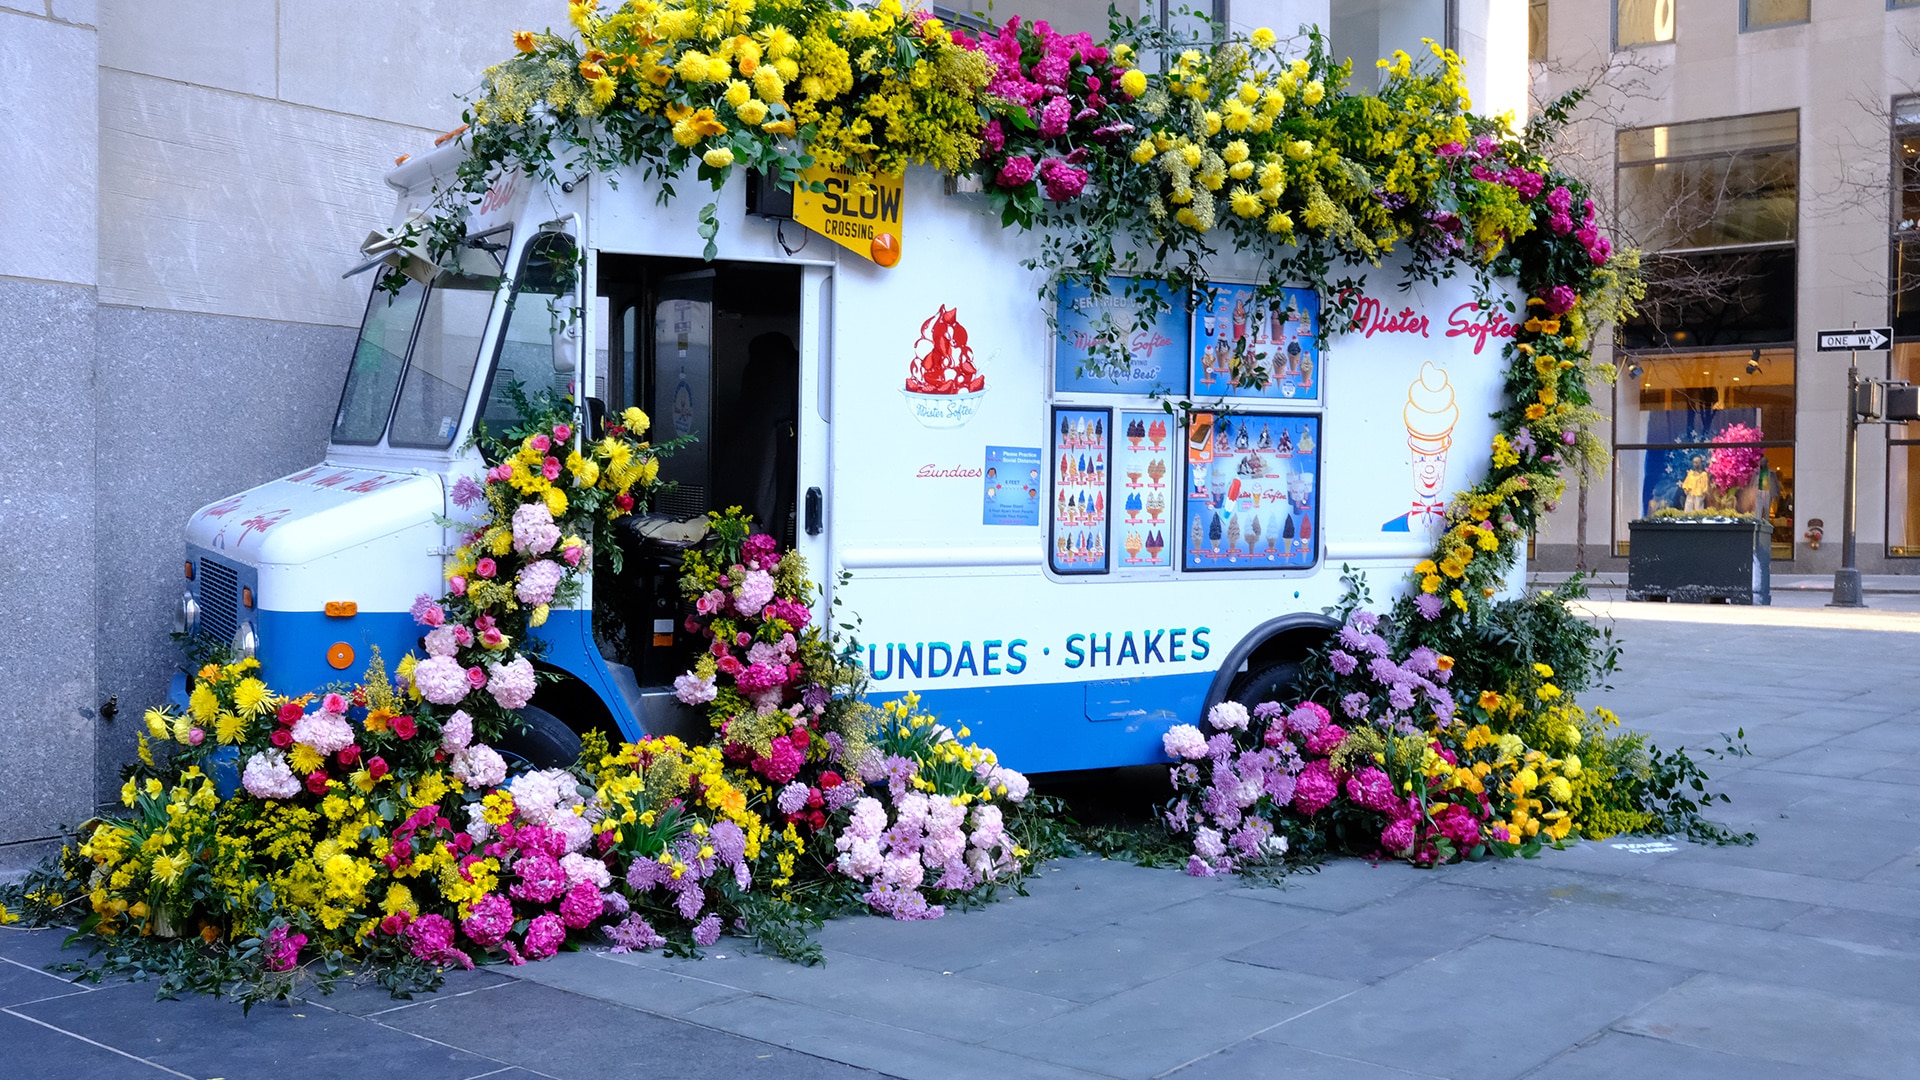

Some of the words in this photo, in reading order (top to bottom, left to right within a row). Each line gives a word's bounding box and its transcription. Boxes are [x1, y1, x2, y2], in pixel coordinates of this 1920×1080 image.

[822, 177, 901, 224] SLOW
[825, 219, 874, 240] CROSSING
[1073, 297, 1127, 309] CERTFIED
[1130, 297, 1172, 315] VENOR
[1339, 288, 1430, 339] Mister
[1445, 302, 1521, 355] Softee
[1132, 331, 1173, 358] Softee
[1827, 337, 1848, 346] ONE
[1858, 335, 1881, 345] WAY
[916, 403, 944, 418] Mister
[946, 402, 973, 421] Softee
[916, 463, 983, 478] Sundaes
[1064, 626, 1211, 669] SHAKES
